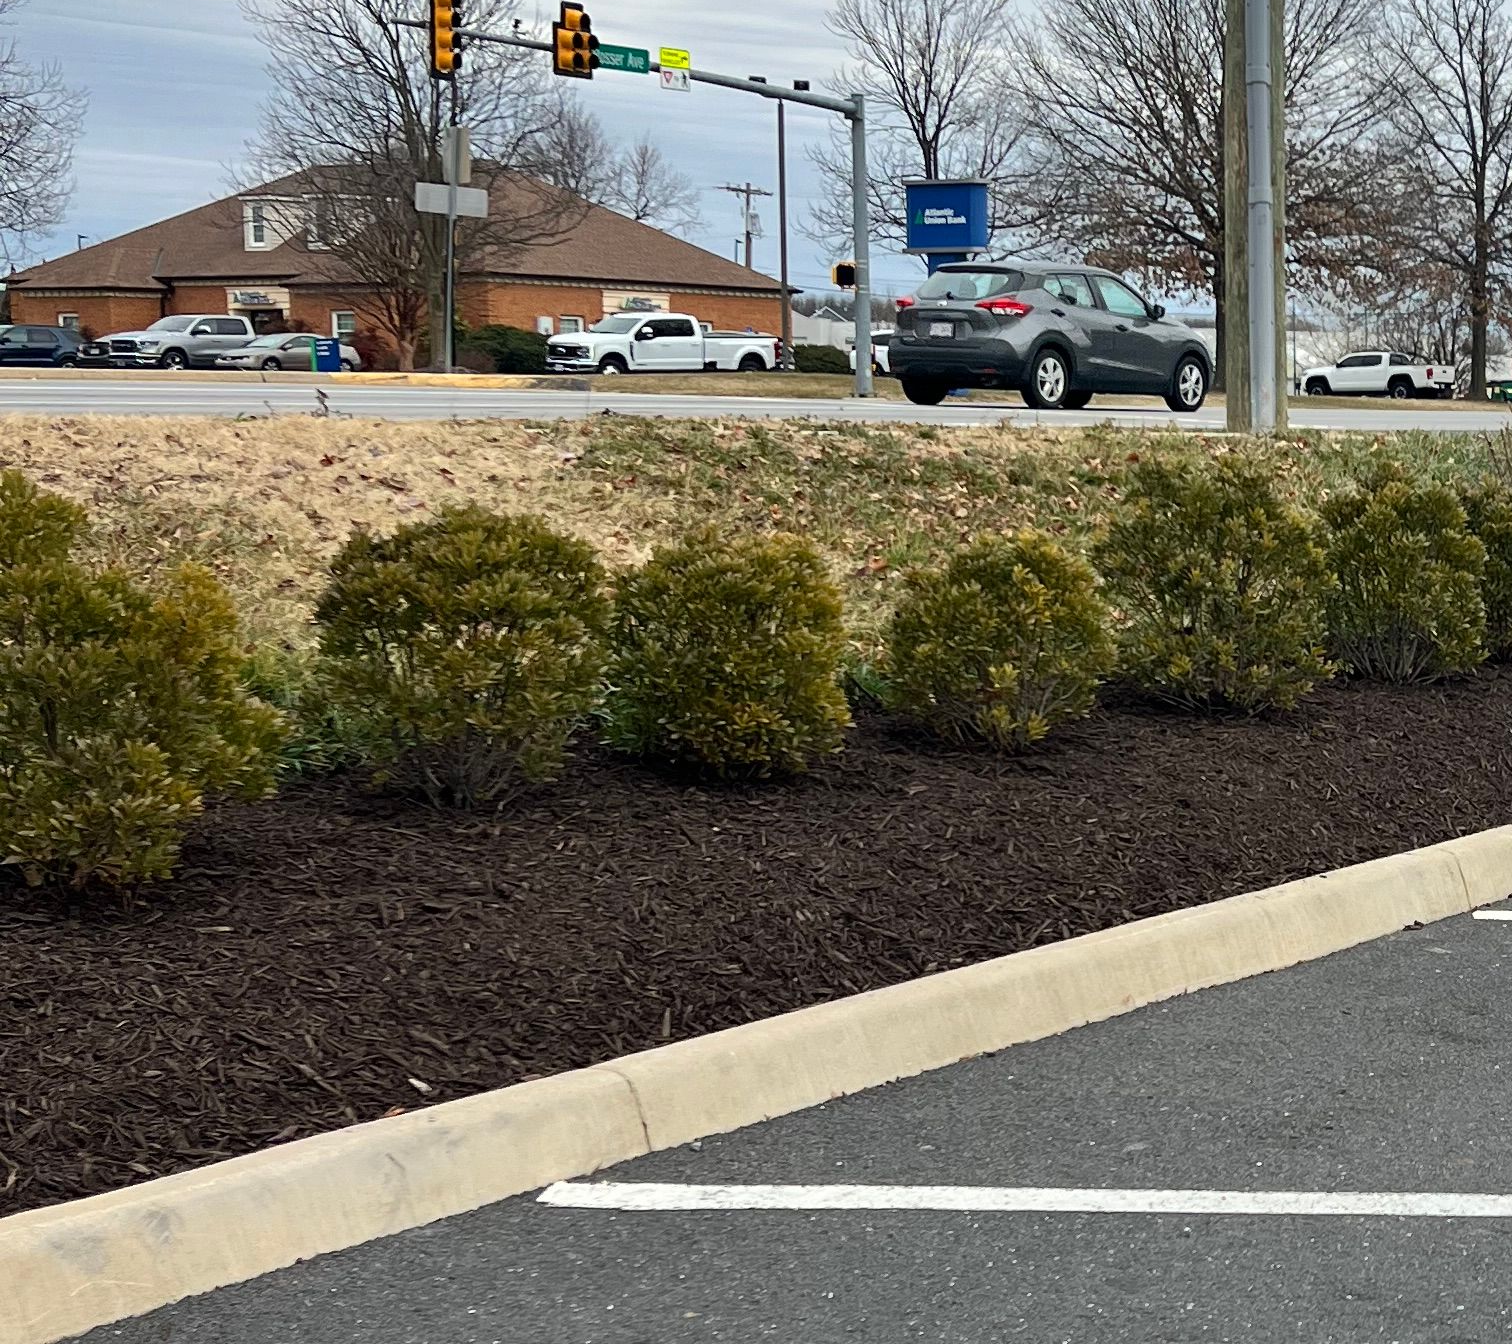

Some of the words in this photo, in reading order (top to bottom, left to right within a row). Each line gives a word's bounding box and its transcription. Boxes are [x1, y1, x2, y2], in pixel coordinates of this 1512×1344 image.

[627, 52, 645, 69] Ave
[924, 208, 955, 217] Atlantic
[924, 216, 947, 225] Union
[947, 215, 967, 225] Bank
